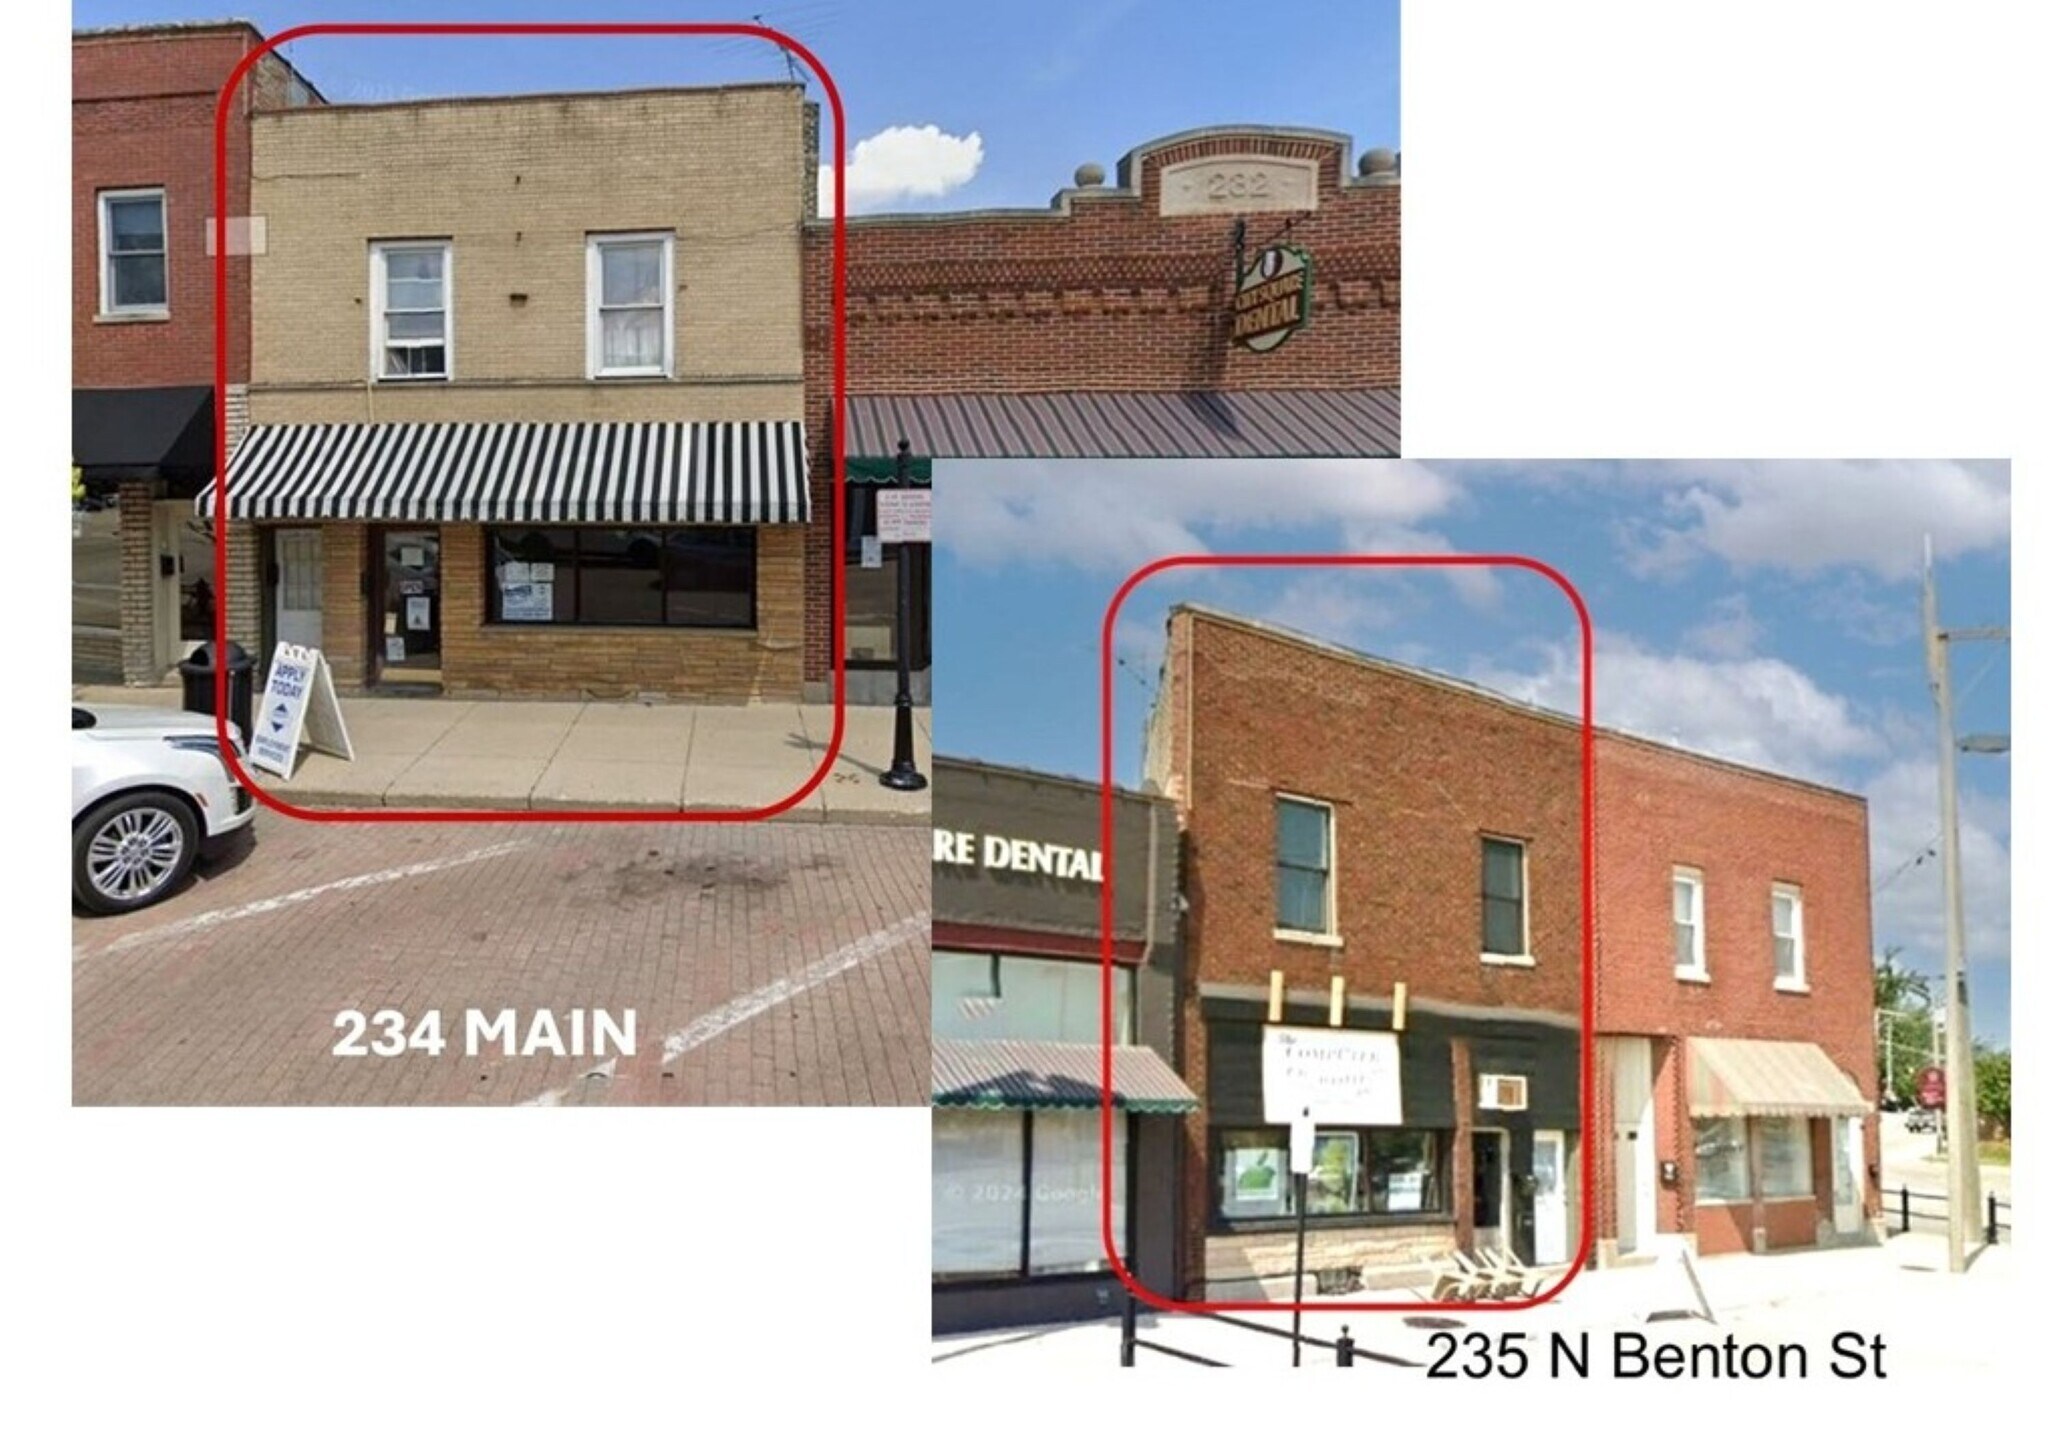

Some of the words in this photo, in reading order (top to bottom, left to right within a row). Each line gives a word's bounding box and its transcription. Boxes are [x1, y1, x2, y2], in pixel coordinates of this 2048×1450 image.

[1208, 172, 1268, 200] 232
[1235, 293, 1301, 336] DENTAL
[275, 663, 307, 682] APPLY
[270, 679, 304, 699] TODAY
[932, 828, 975, 865] RE
[983, 834, 1104, 882] DENTAL
